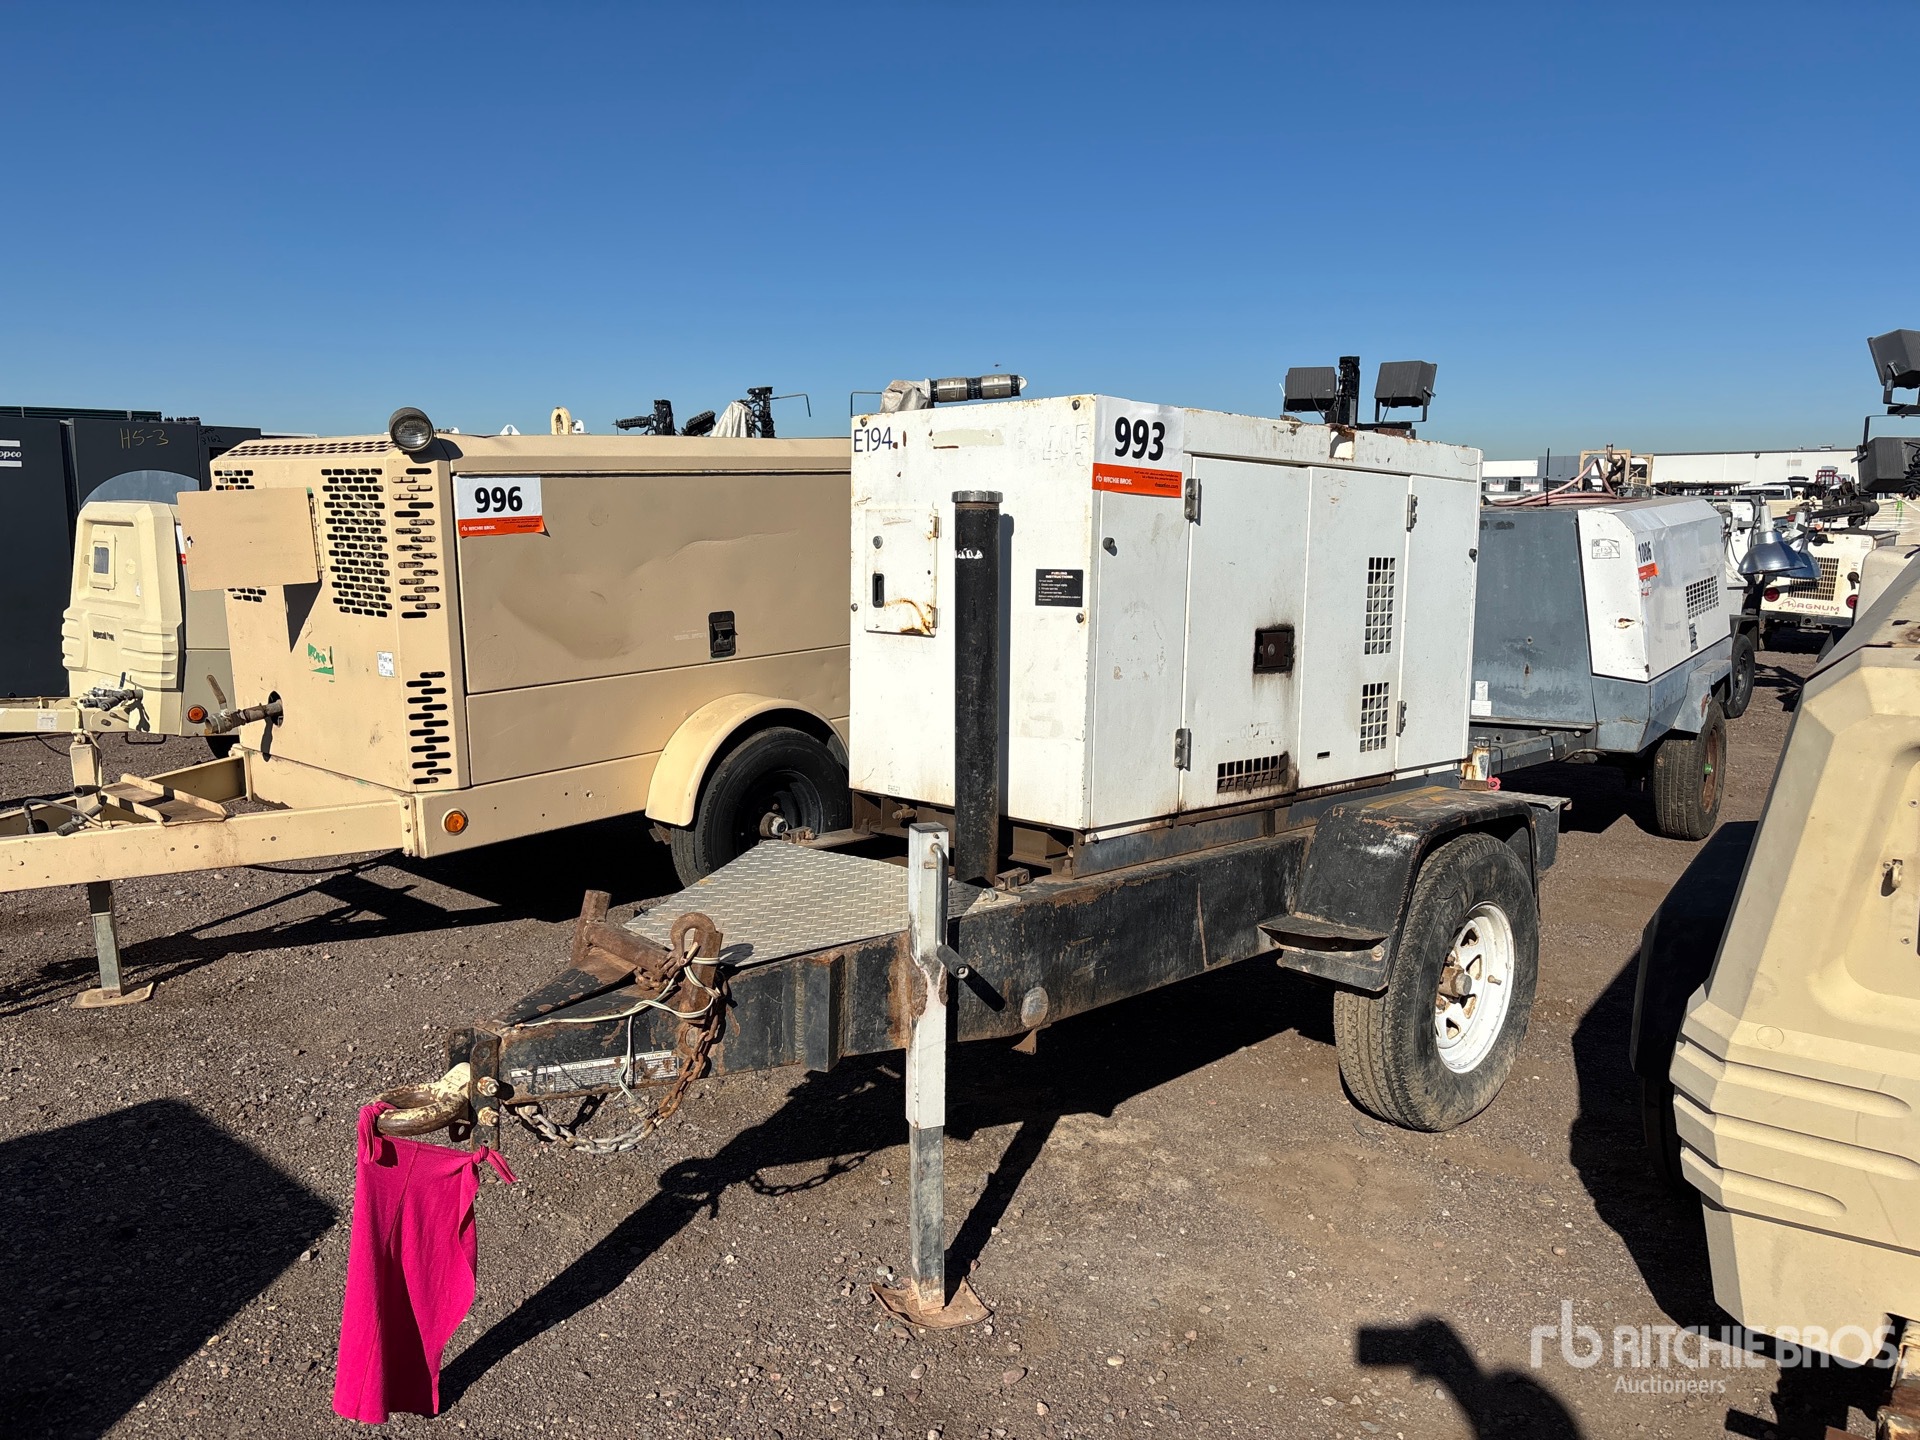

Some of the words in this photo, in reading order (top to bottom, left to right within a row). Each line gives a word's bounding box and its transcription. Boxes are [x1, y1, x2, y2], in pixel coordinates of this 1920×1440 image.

[854, 427, 893, 453] E194
[1114, 416, 1166, 462] 993
[1103, 476, 1119, 484] RITCHIE
[474, 486, 523, 513] 996
[1782, 599, 1840, 612] MAGNUM
